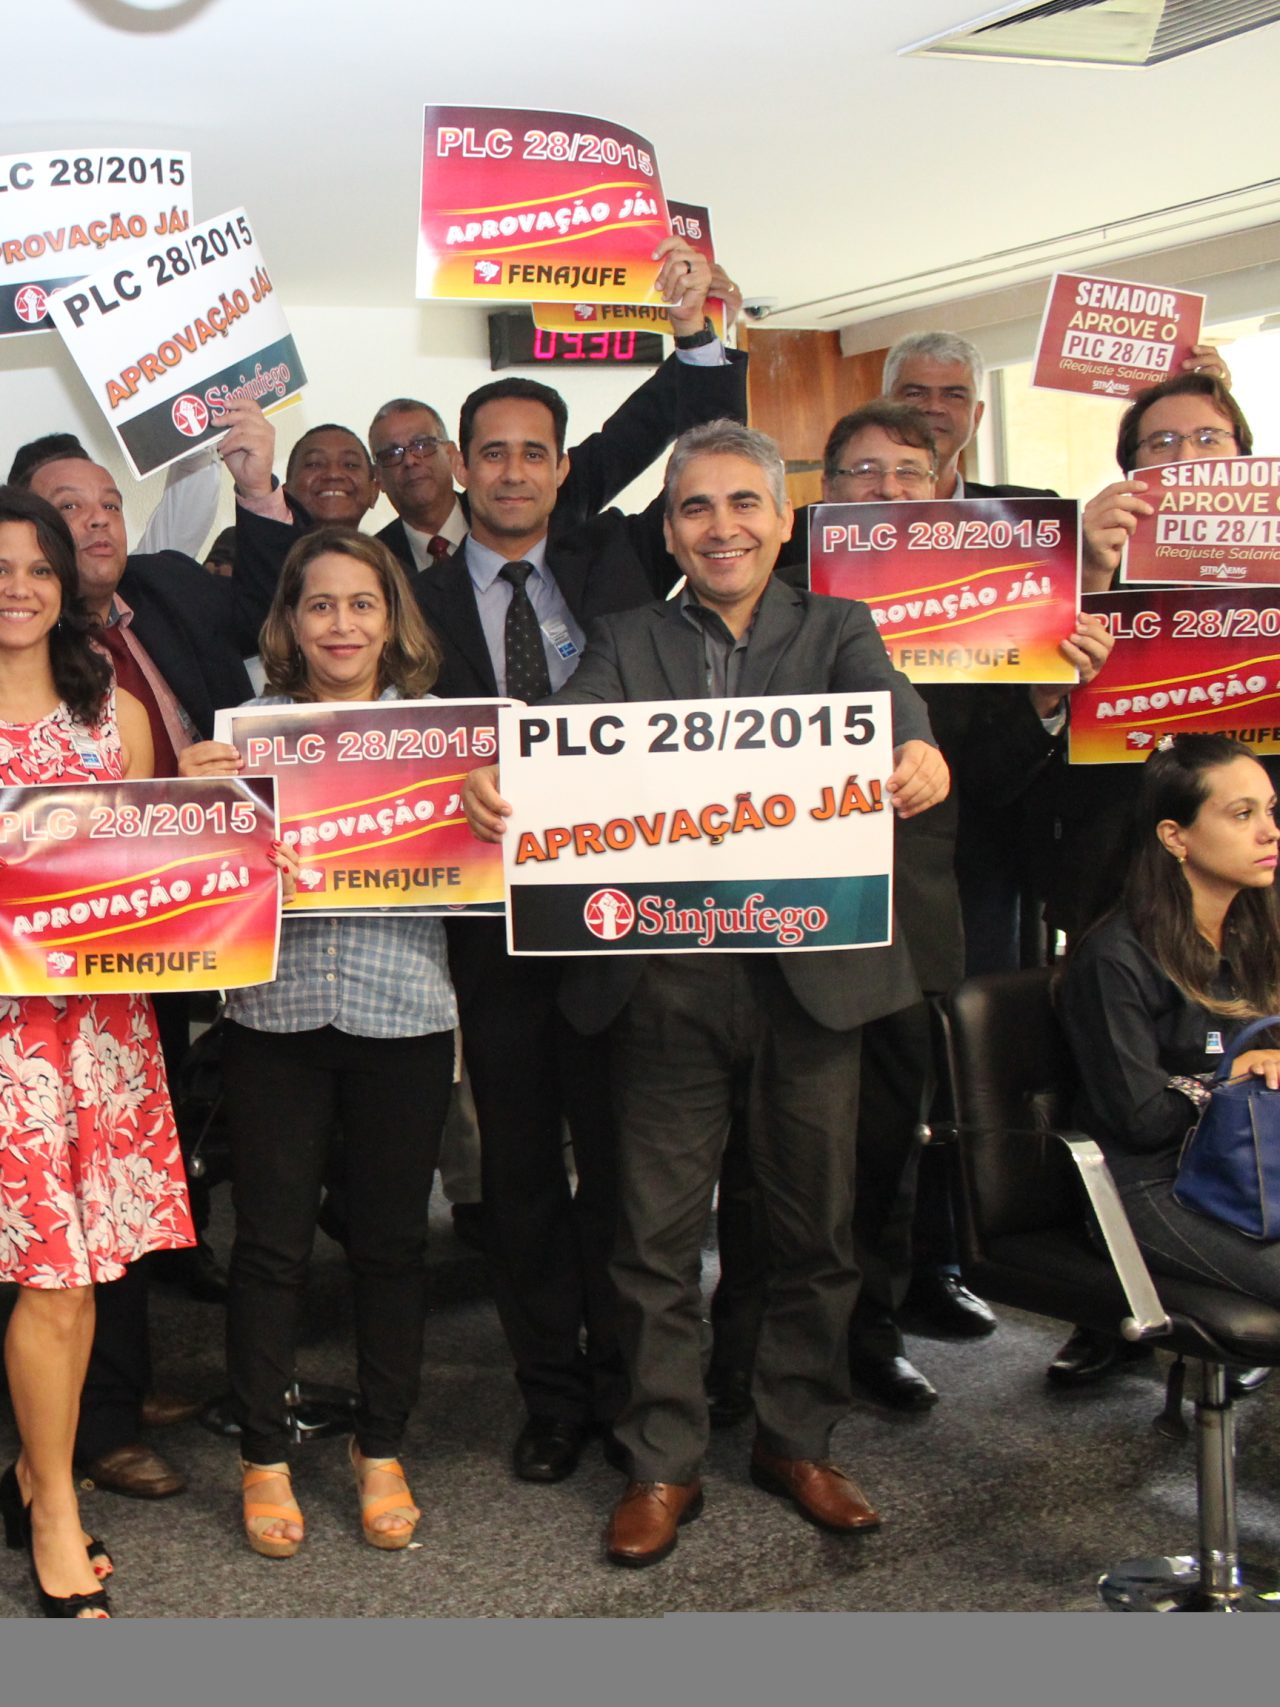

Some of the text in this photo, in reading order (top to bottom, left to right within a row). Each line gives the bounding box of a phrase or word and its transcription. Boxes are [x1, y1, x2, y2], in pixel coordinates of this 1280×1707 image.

[437, 127, 654, 176] PLC 28/2015
[49, 156, 186, 187] 28/2015
[154, 205, 189, 235] JÁ!
[446, 191, 658, 244] APROVAÇÃO JÁ!
[63, 216, 253, 328] PLC 28/2015
[509, 264, 627, 287] FENAJUFE
[601, 304, 670, 321] FENAJU
[1075, 281, 1181, 322] SENADOR,
[105, 266, 273, 408] APROVAÇÃO JÁ!
[1068, 311, 1178, 341] APROVE O
[1059, 358, 1114, 376] (Reajuste
[1068, 335, 1168, 367] PLC 28/15
[1159, 492, 1269, 512] APROVE
[823, 519, 1061, 553] PLC 28/2015
[1163, 519, 1207, 541] PLC
[1155, 546, 1280, 561] (Reajuste Salaria
[871, 572, 1051, 626] ROVAÇÃO JÁ!
[1172, 609, 1280, 638] 28/20
[900, 647, 1020, 668] FENAJUFE
[1096, 674, 1267, 719] APROVAÇÃO
[247, 727, 496, 767] PLC 28/2015
[519, 704, 876, 758] PLC 28/2015
[90, 801, 257, 839] 28/2015
[283, 798, 435, 848] PROVAÇÃO
[515, 775, 884, 865] APROVAÇÃO JÁ!
[333, 866, 461, 891] FENAJUFE
[12, 861, 249, 936] APROVAÇÃO JÁ!
[638, 894, 828, 946] Sinjufego
[85, 950, 217, 977] FENAJUFE
